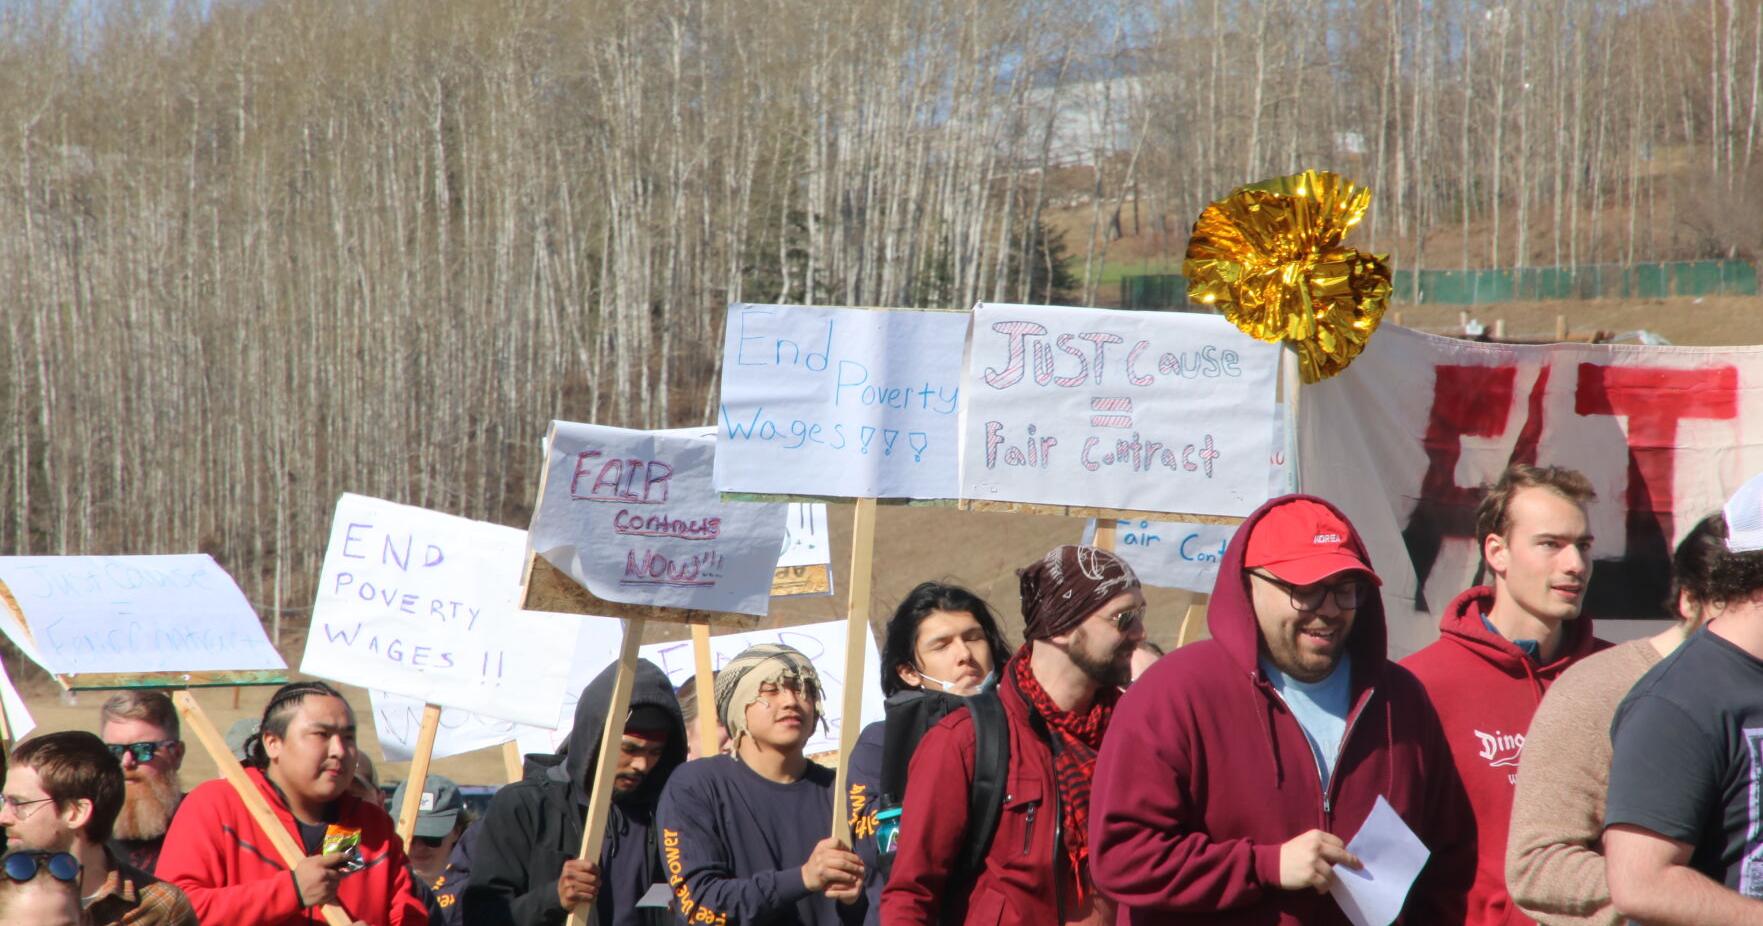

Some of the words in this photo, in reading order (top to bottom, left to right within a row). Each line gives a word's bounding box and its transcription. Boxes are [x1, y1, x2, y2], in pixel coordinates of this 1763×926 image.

[739, 311, 834, 372] End
[982, 320, 1124, 390] JUST
[835, 360, 959, 414] Poverty
[570, 450, 673, 502] FAIR
[985, 420, 1057, 470] Fair
[1081, 432, 1221, 478] Contract
[343, 523, 445, 572] END
[335, 572, 480, 631] POVERTY
[324, 623, 454, 669] WAGES
